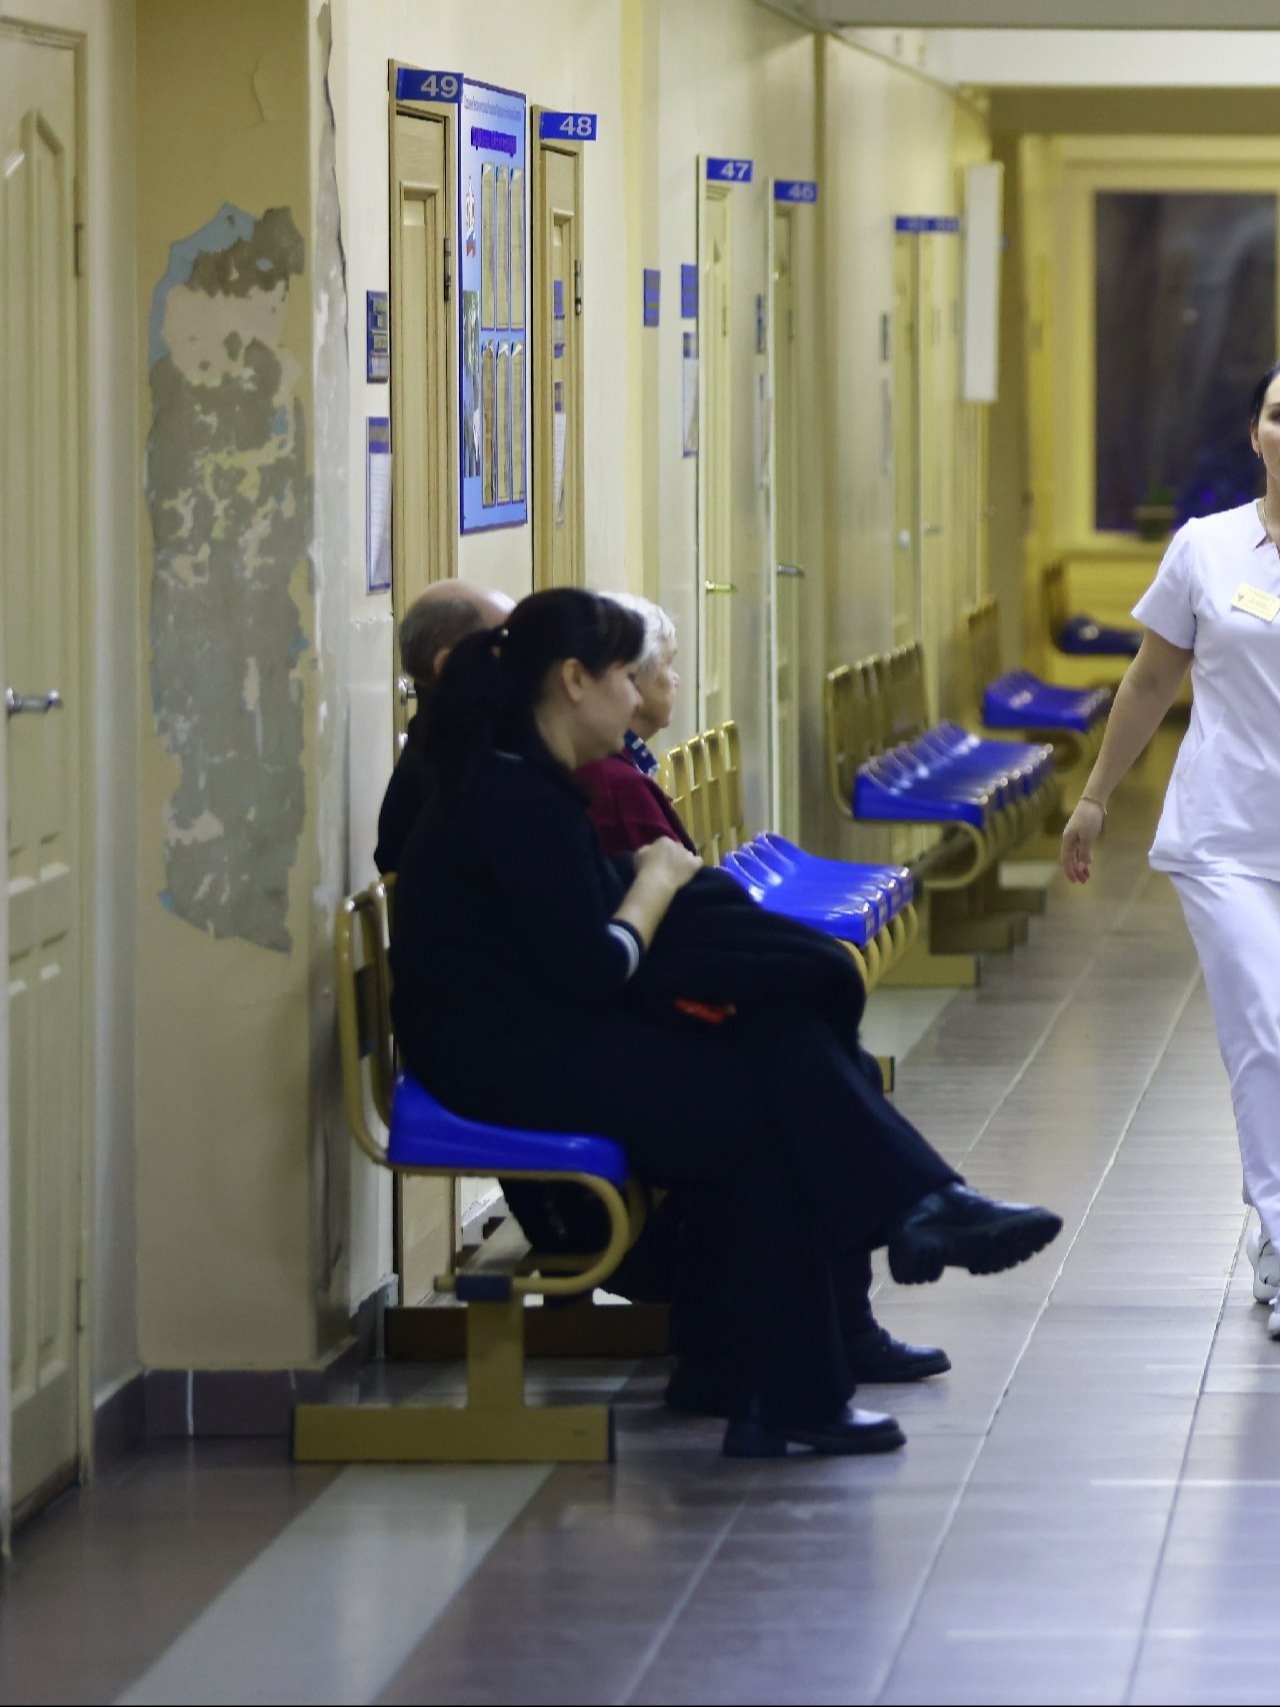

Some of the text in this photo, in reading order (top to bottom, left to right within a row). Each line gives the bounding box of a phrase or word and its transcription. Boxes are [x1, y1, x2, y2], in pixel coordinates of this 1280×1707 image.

[421, 74, 459, 98] 49
[559, 115, 592, 137] 48
[720, 161, 749, 180] 47
[787, 183, 815, 200] 46
